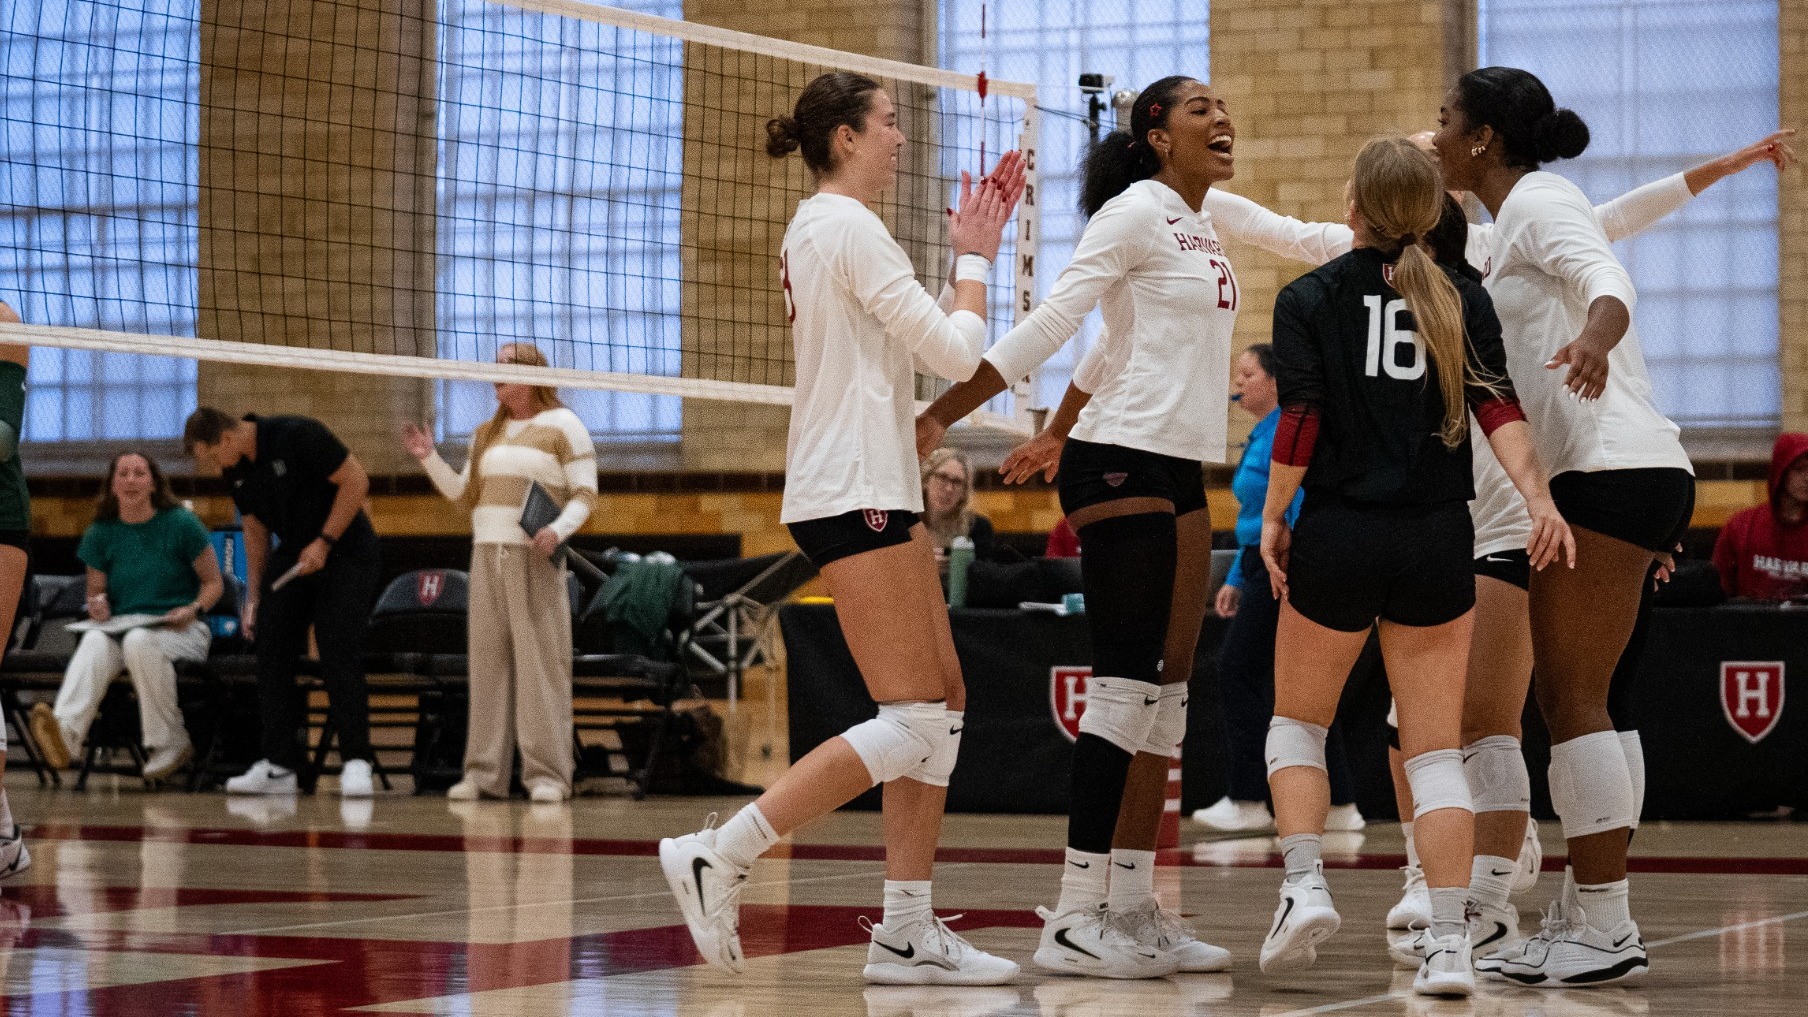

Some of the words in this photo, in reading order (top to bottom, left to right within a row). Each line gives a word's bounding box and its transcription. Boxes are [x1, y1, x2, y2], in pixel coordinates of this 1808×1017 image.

[1021, 148, 1035, 383] CRIMS
[1173, 232, 1225, 257] HARVAR
[1208, 258, 1237, 311] 21
[1363, 294, 1427, 380] 16
[1734, 671, 1770, 719] H
